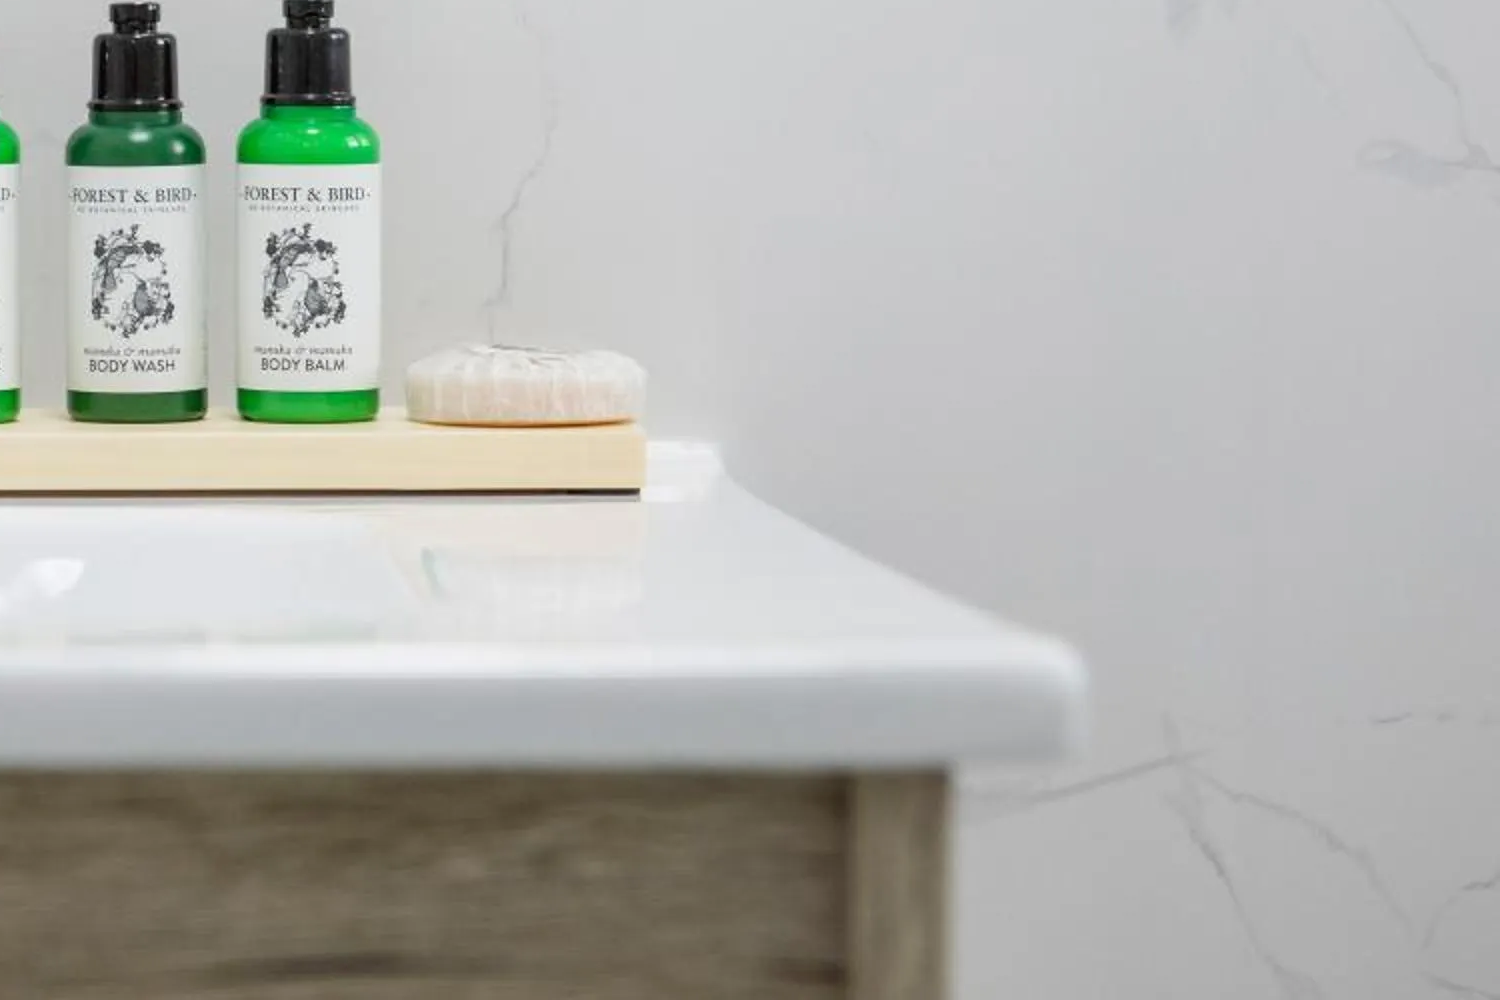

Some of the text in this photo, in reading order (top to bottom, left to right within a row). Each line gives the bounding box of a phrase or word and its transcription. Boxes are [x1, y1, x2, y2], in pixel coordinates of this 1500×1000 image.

[72, 187, 192, 203] FOREST & BIRD
[244, 186, 365, 202] FOREST & BIRD
[89, 359, 176, 373] BODY WASH
[260, 357, 345, 371] BODY BALM
